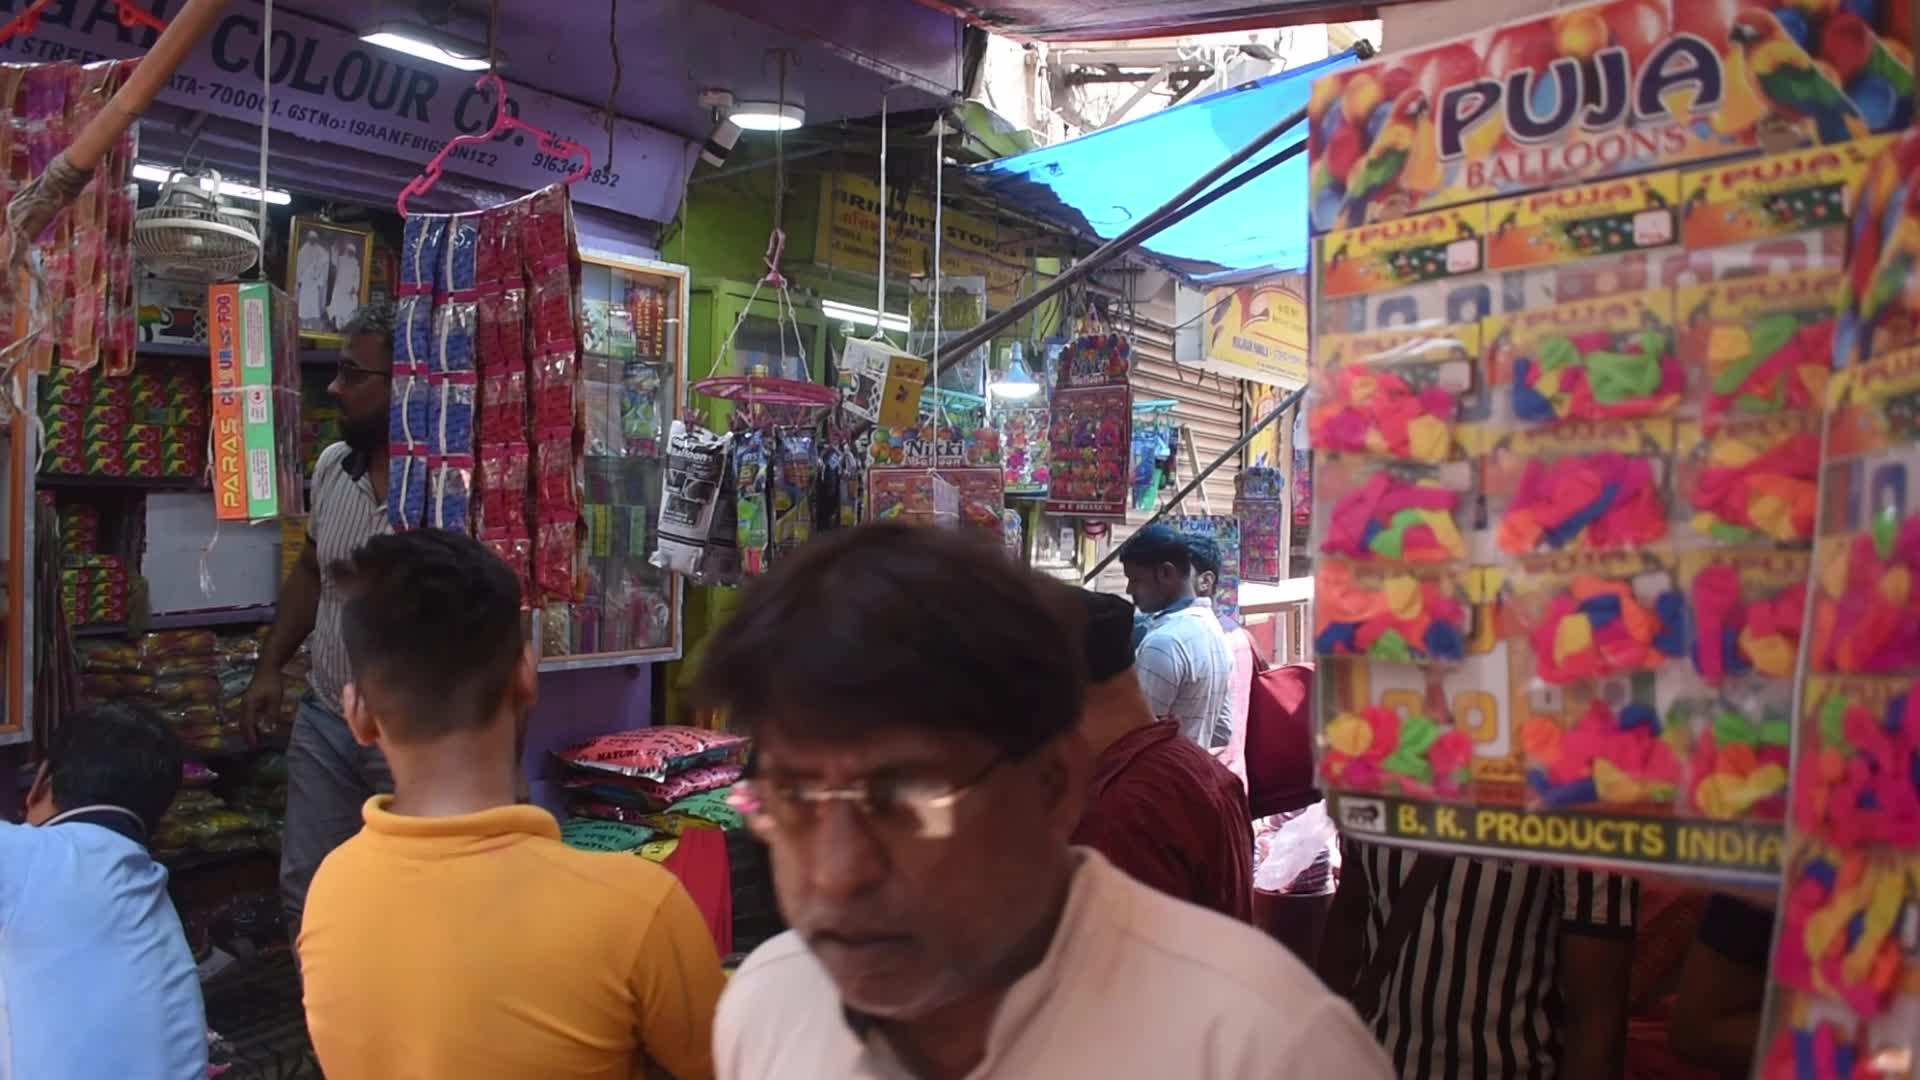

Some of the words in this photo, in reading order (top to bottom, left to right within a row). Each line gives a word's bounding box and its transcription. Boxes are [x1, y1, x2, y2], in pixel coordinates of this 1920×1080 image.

[210, 14, 438, 124] COLOUR
[453, 86, 525, 147] CO.
[1440, 35, 1722, 158] PUJA
[1465, 126, 1686, 188] BALLOONS
[220, 417, 240, 507] PARAS
[1398, 804, 1427, 833] B.
[1435, 807, 1467, 838] K.
[1475, 812, 1666, 857] PRODUCTS
[1676, 827, 1785, 866] INDIA
